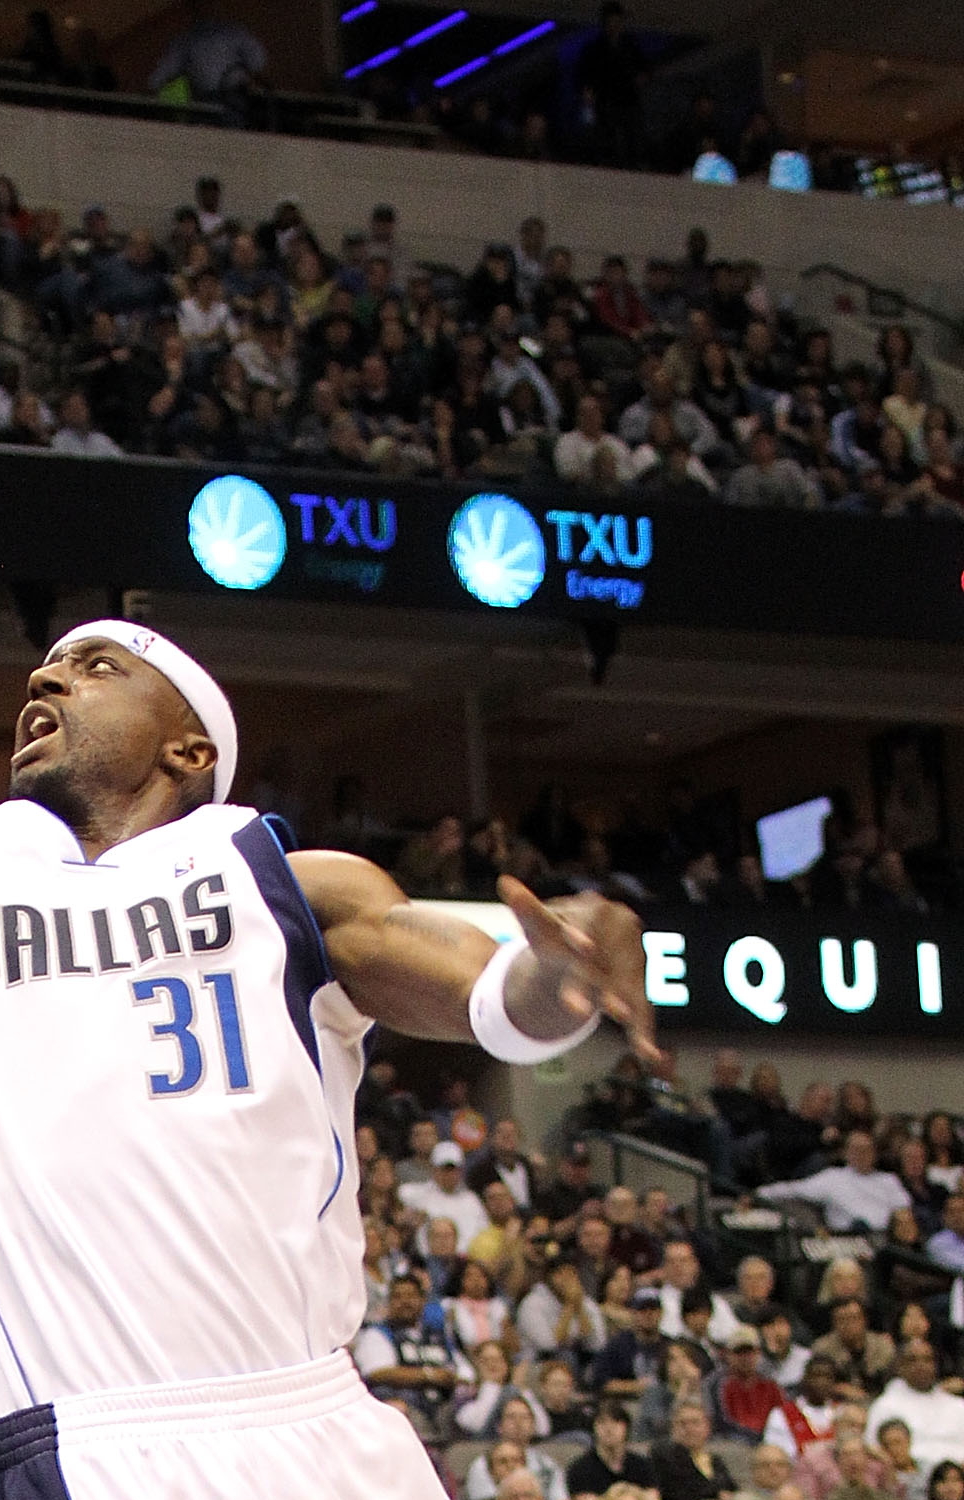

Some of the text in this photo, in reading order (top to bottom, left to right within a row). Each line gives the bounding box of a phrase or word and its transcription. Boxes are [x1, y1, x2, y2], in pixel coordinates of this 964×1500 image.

[290, 493, 398, 551] TXU
[546, 510, 652, 568] TXU
[566, 569, 644, 609] Energy
[128, 969, 255, 1100] 31
